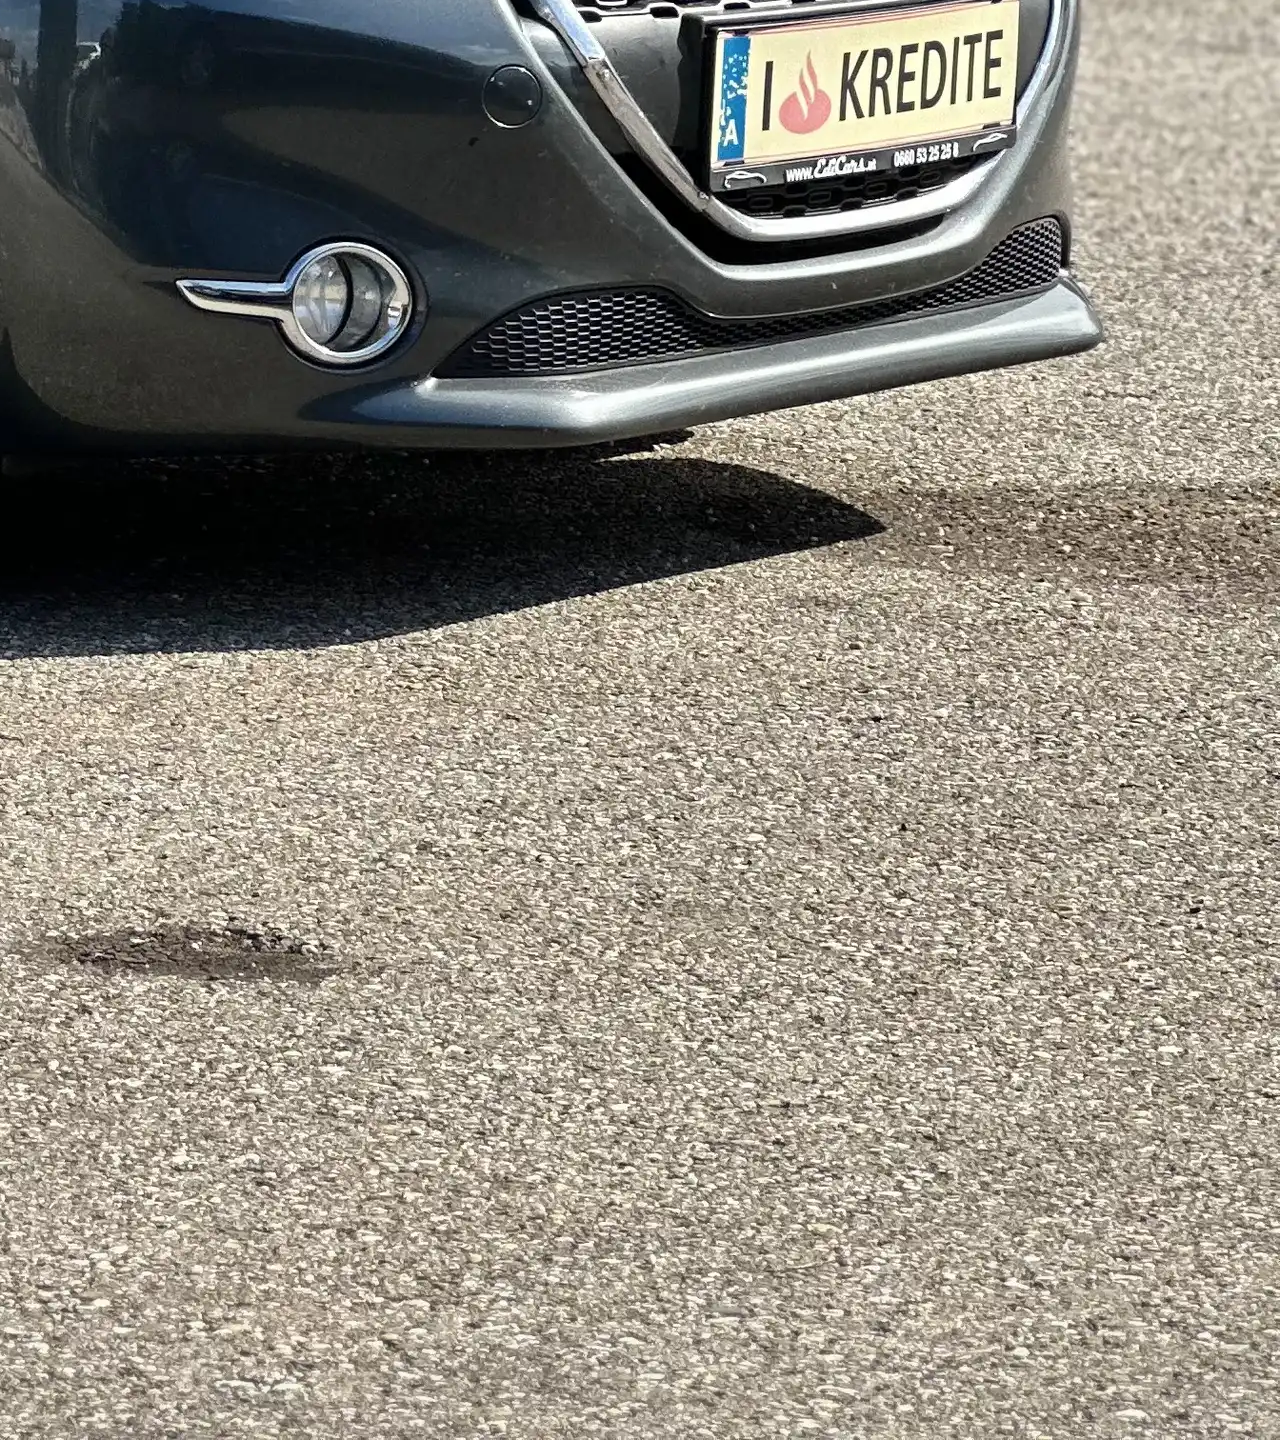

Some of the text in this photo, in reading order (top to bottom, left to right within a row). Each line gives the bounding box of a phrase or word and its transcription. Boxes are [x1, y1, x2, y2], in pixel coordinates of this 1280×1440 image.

[761, 29, 1004, 131] I KREDITE
[722, 119, 739, 147] A
[916, 147, 927, 164] 53
[928, 145, 940, 162] 25
[940, 143, 952, 160] 25
